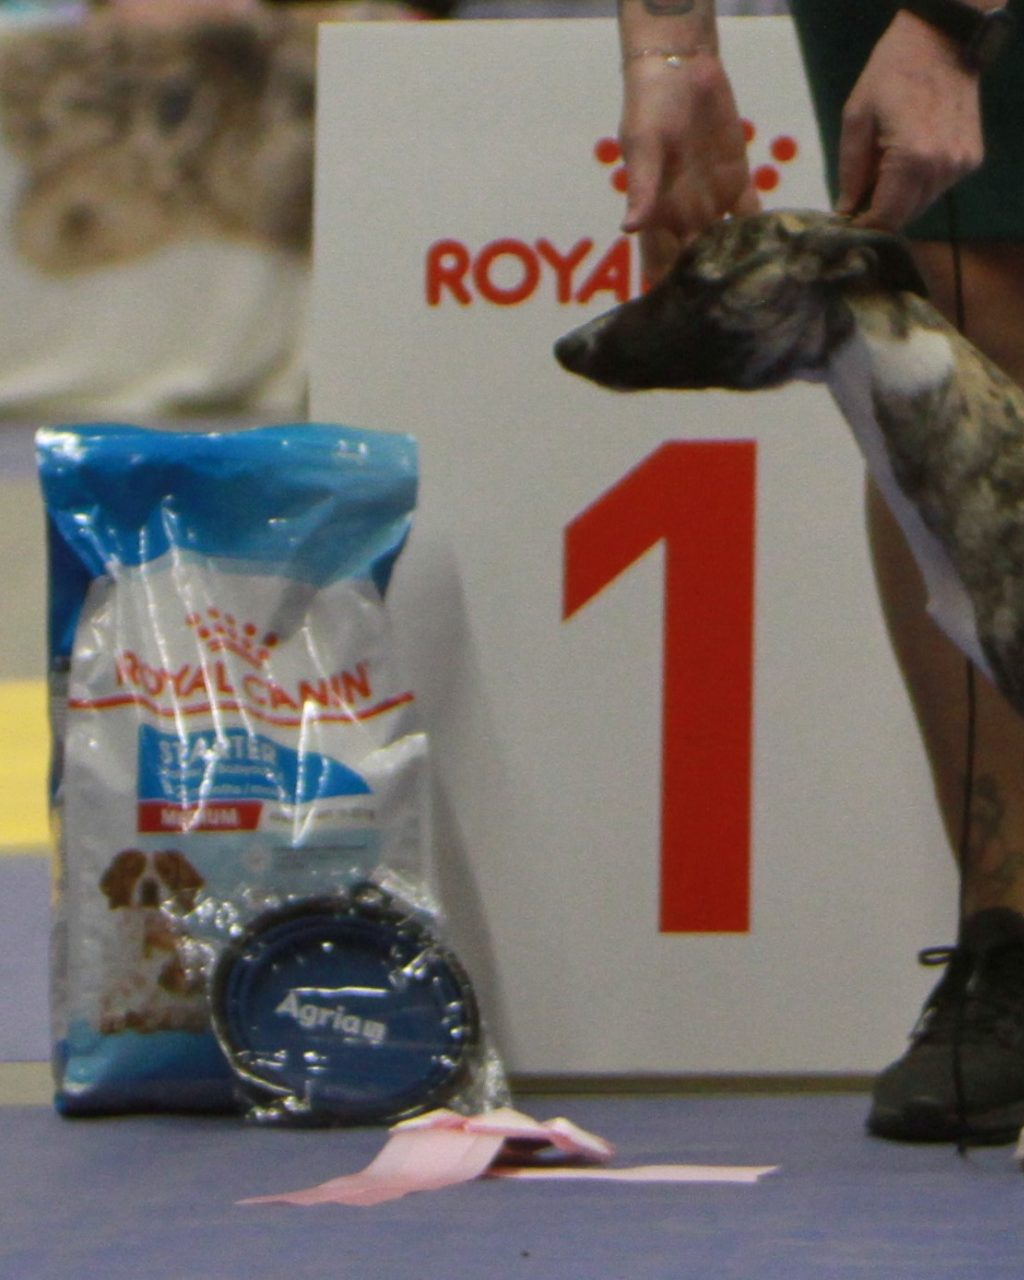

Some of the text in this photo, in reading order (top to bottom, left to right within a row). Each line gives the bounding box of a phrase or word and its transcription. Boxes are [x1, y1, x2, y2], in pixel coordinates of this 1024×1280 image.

[426, 238, 651, 307] ROYA
[115, 650, 371, 710] ROYAL CANIN
[562, 439, 757, 934] 1
[159, 734, 277, 766] STATER
